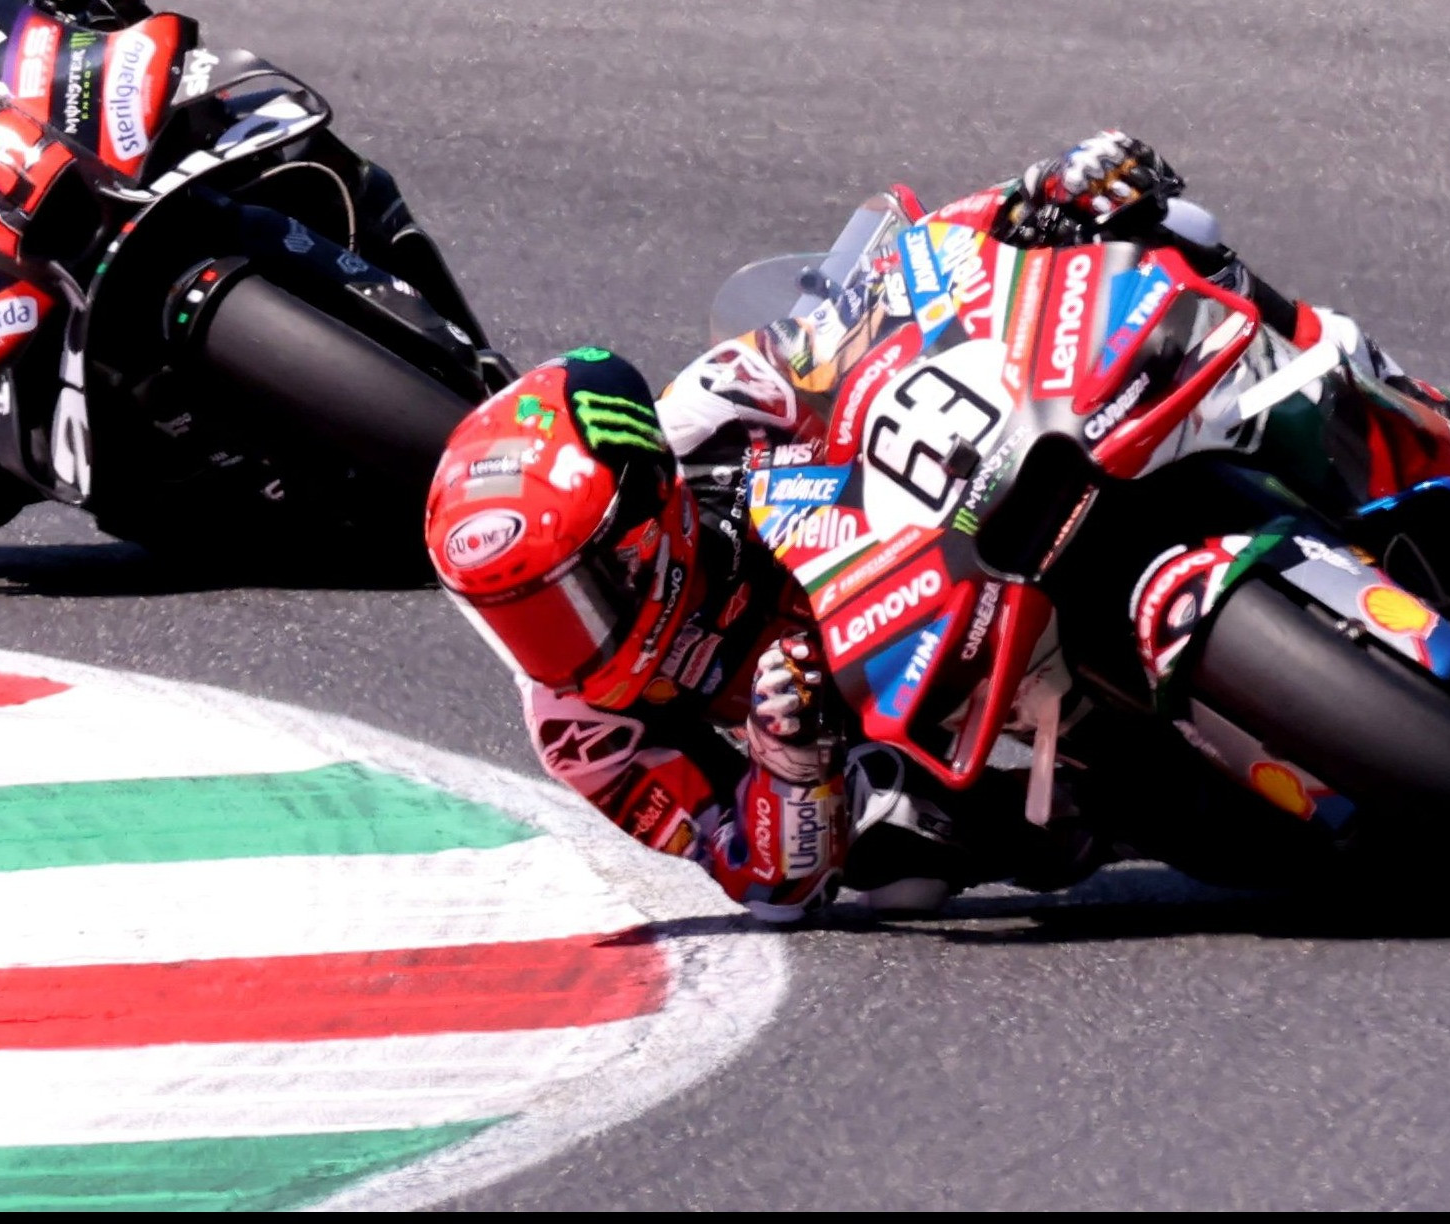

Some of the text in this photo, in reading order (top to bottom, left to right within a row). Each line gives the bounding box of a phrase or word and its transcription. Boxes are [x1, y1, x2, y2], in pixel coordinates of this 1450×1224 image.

[64, 49, 87, 134] MONSTER
[116, 39, 146, 153] sterilgarda
[185, 48, 220, 97] sky
[1042, 254, 1092, 390] Lenovo
[866, 365, 1002, 513] 63
[768, 473, 839, 502] ADVANCE
[829, 569, 943, 657] Lenovo
[905, 630, 941, 683] TIM
[789, 794, 826, 872] Unipol
